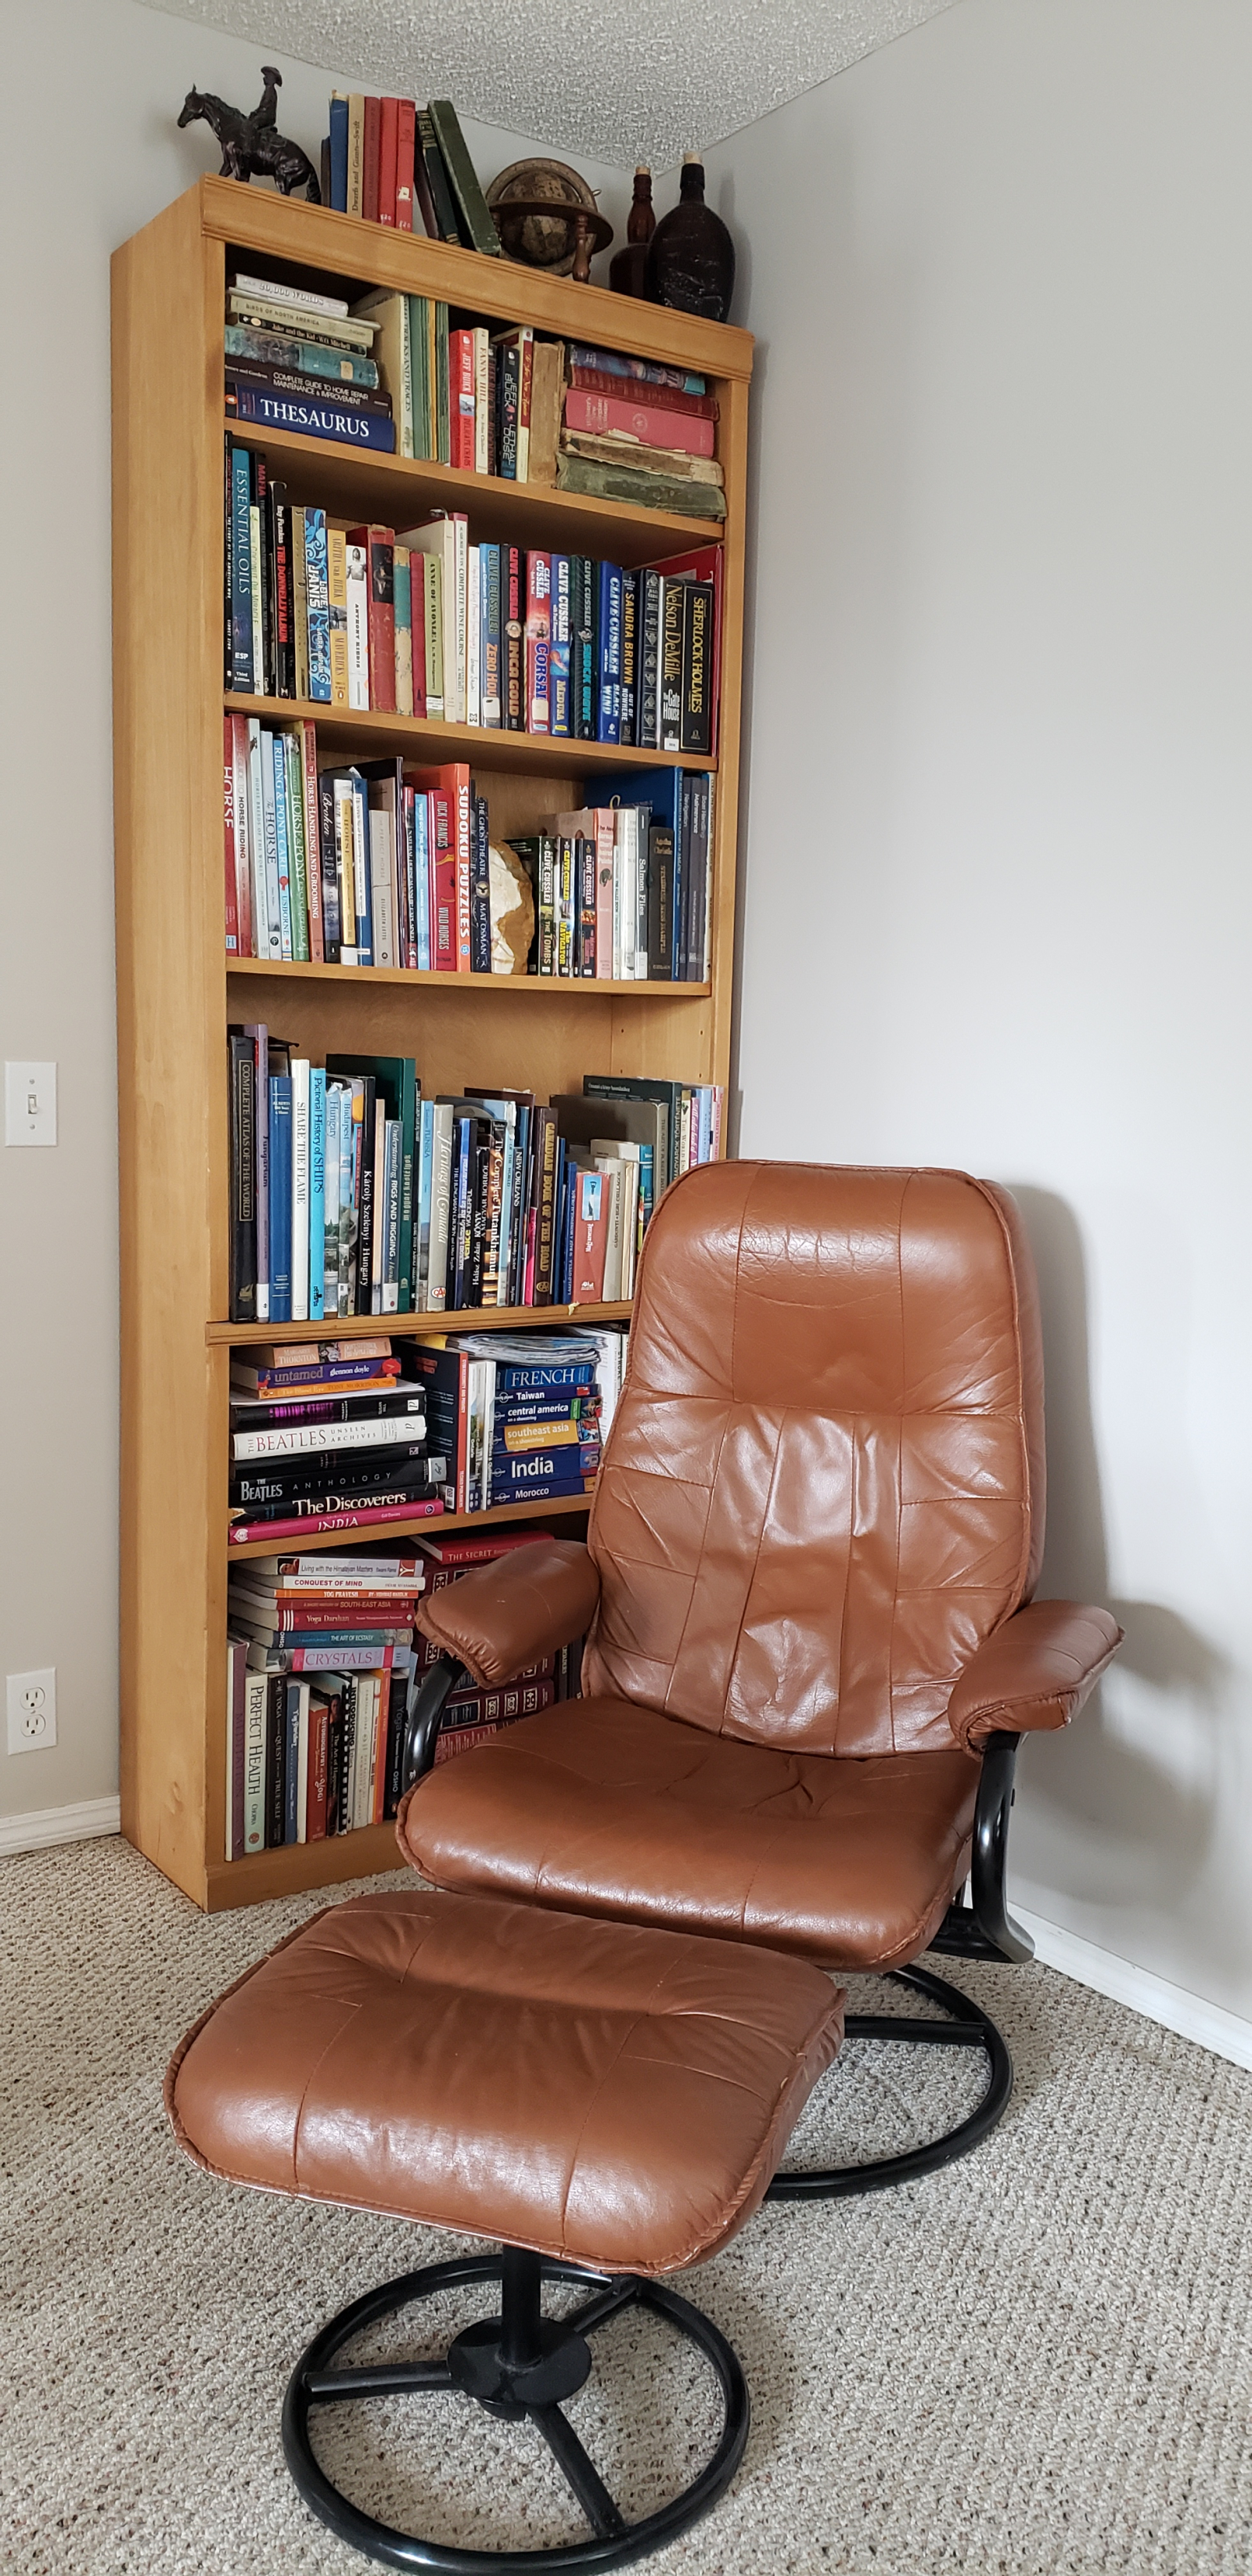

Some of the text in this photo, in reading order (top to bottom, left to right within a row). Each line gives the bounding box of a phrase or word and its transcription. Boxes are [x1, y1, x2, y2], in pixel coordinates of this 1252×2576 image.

[246, 303, 263, 313] BIRDS
[275, 311, 293, 320] NORTH
[296, 315, 320, 326] AMERICA
[292, 291, 324, 305] WORDS
[273, 372, 303, 386] COMPLETE
[304, 379, 322, 390] GUIDE
[332, 386, 350, 396] HOME
[351, 391, 369, 400] REPAIR
[462, 353, 472, 392] JEFF BUICK
[260, 398, 369, 437] THESAURUS
[321, 391, 361, 405] IMPROVEMENT
[257, 464, 266, 496] MAFIA
[236, 470, 250, 595] ESSENTIAL OILS
[277, 546, 287, 643] THE DONNELLY ALBUM
[308, 565, 328, 609] LOVE, JANIS
[488, 549, 498, 634] CLIVE CUSSLER
[536, 560, 545, 599] CUSSLER
[558, 561, 568, 642] CLIVE CUSSLER
[609, 577, 620, 675] CLIVE CUSSLER
[624, 593, 635, 684] SANDRA BROWN
[664, 584, 682, 681] Nelson DeMille
[334, 637, 345, 676] MAVERICKS
[691, 596, 704, 713] SHERLOCK HOLMES
[509, 640, 519, 716] INCA GOLD
[274, 747, 287, 870] RIDING PONY CARE
[322, 792, 333, 836] Broken
[437, 802, 448, 847] DICK FRANCIS
[266, 811, 276, 864] HORSE
[477, 816, 486, 843] GHOST
[459, 785, 470, 938] SUDOKU PUZZLES
[542, 850, 552, 903] CLIVE CUSSLER
[438, 906, 449, 949] WILD HORSES
[558, 921, 567, 964] NAVIGATOR
[312, 1077, 324, 1194] Pictorial History of SHIPS
[327, 1101, 339, 1139] Hungary
[341, 1103, 351, 1140] Budapest
[241, 1064, 250, 1218] COMPLETE ATLAS OF THE WORLD
[296, 1101, 306, 1205] SHARE THE FLAME
[495, 1138, 504, 1155] The
[390, 1180, 398, 1200] RIGS
[491, 1158, 503, 1202] Complete
[513, 1151, 523, 1207] NEW ORLEANS
[539, 1122, 556, 1272] CANADIAN BOOK OF THE ROAD
[360, 1169, 372, 1287] Károly Szelényi Hungary
[389, 1222, 398, 1257] RIGGING
[488, 1203, 502, 1278] Tutankhamun
[275, 1365, 370, 1382] untamed glennon doyle
[511, 1368, 574, 1386] FRENCH
[508, 1403, 569, 1416] central america
[516, 1391, 545, 1400] Taiwan
[257, 1429, 326, 1452] BEATLES
[330, 1425, 366, 1434] UNSEEN
[330, 1432, 376, 1443] ARCHIVES
[508, 1423, 569, 1439] southeast asia
[511, 1457, 554, 1479] India
[292, 1492, 406, 1516] The Discoverers
[515, 1487, 549, 1499] Morocco
[318, 1516, 358, 1531] INDIA
[301, 1565, 314, 1573] Living
[305, 1652, 372, 1666] CRYSTALS
